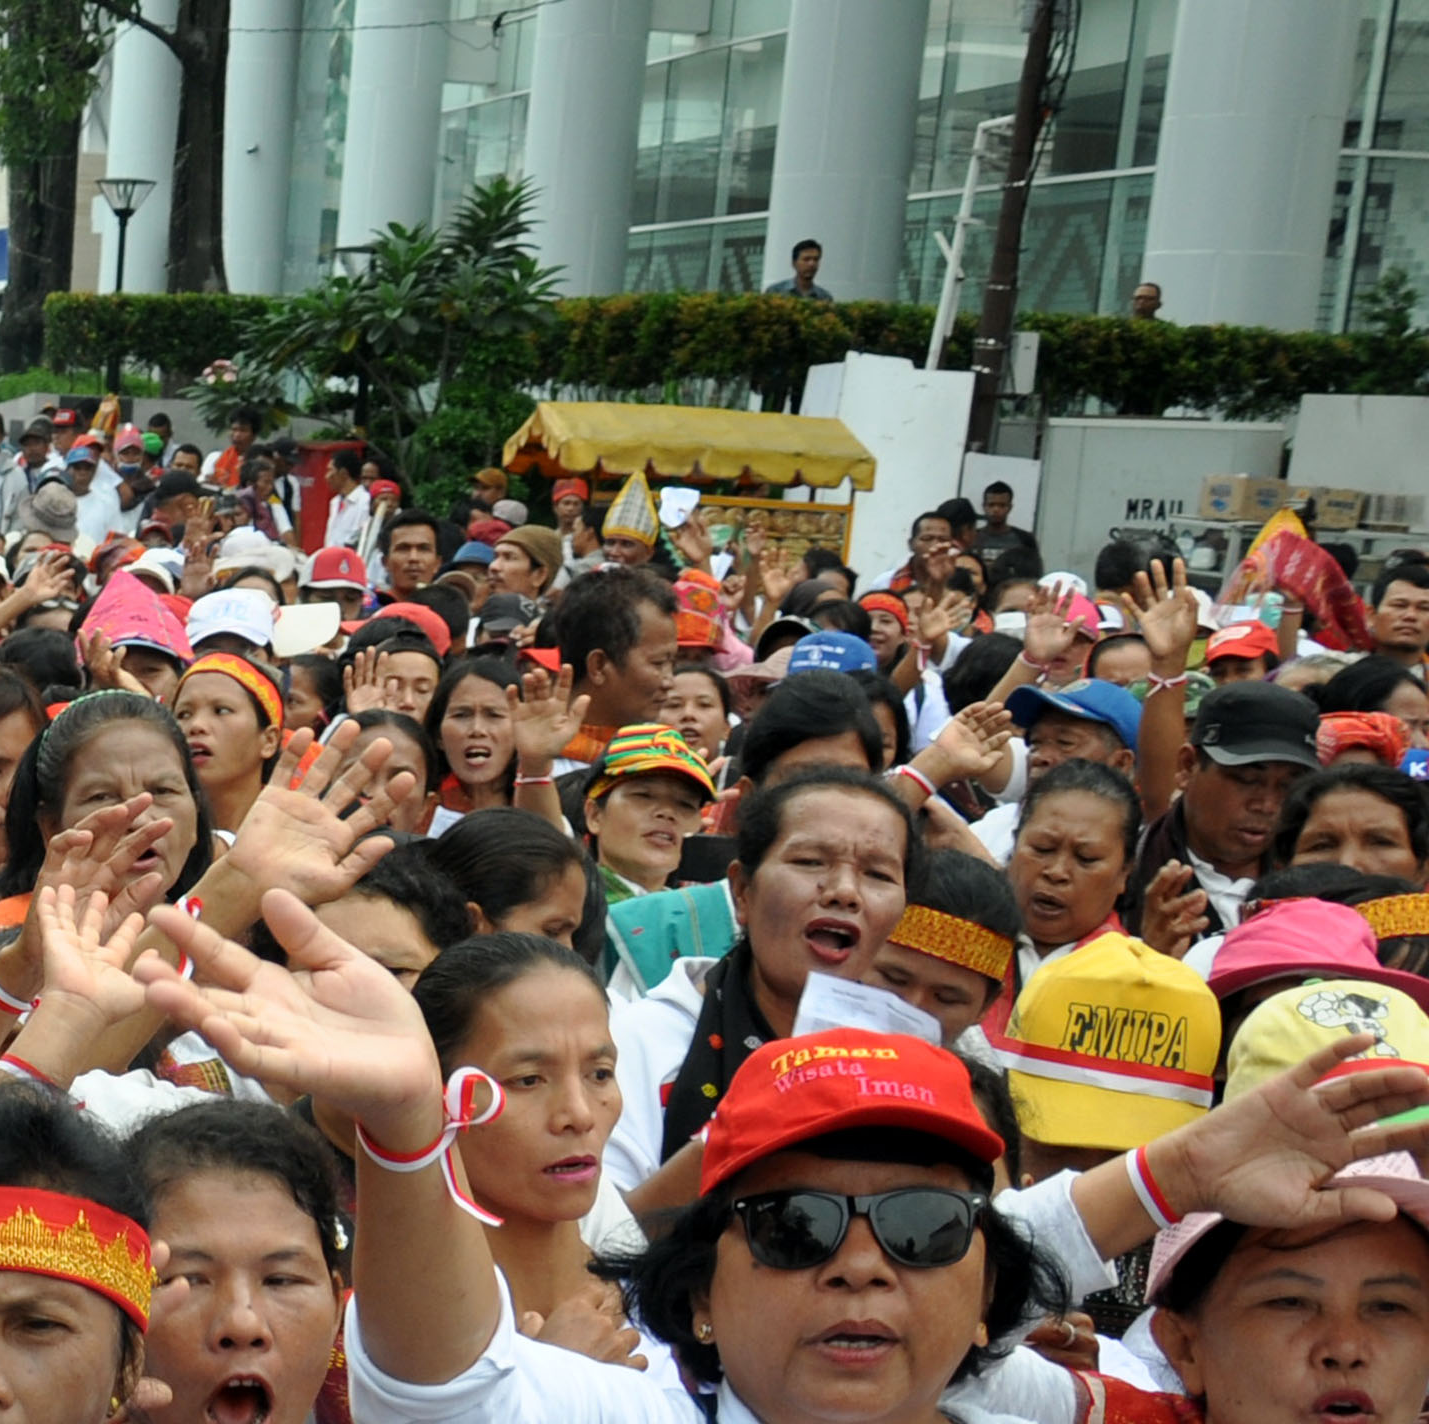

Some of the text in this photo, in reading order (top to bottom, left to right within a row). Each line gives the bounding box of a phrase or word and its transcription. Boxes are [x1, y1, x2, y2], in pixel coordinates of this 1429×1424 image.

[771, 1046, 898, 1079] Taman
[773, 1060, 865, 1093] Wisata
[855, 1076, 936, 1105] Iman
